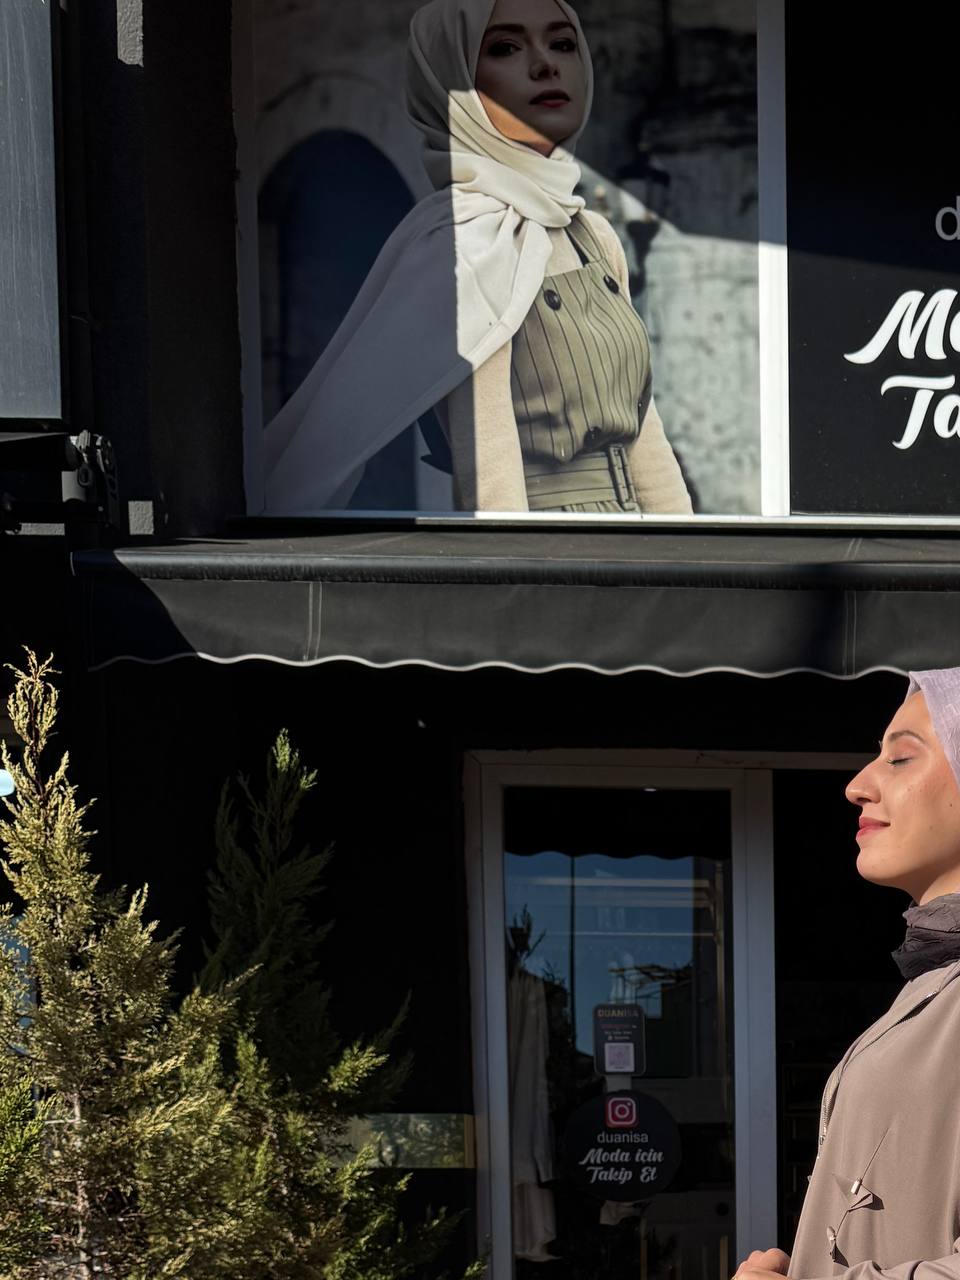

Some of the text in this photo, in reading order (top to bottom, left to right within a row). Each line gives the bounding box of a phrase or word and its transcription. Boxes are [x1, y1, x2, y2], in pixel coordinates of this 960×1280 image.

[597, 1131, 649, 1144] duanisa
[578, 1148, 631, 1165] Moda
[586, 1166, 657, 1184] Takip Et
